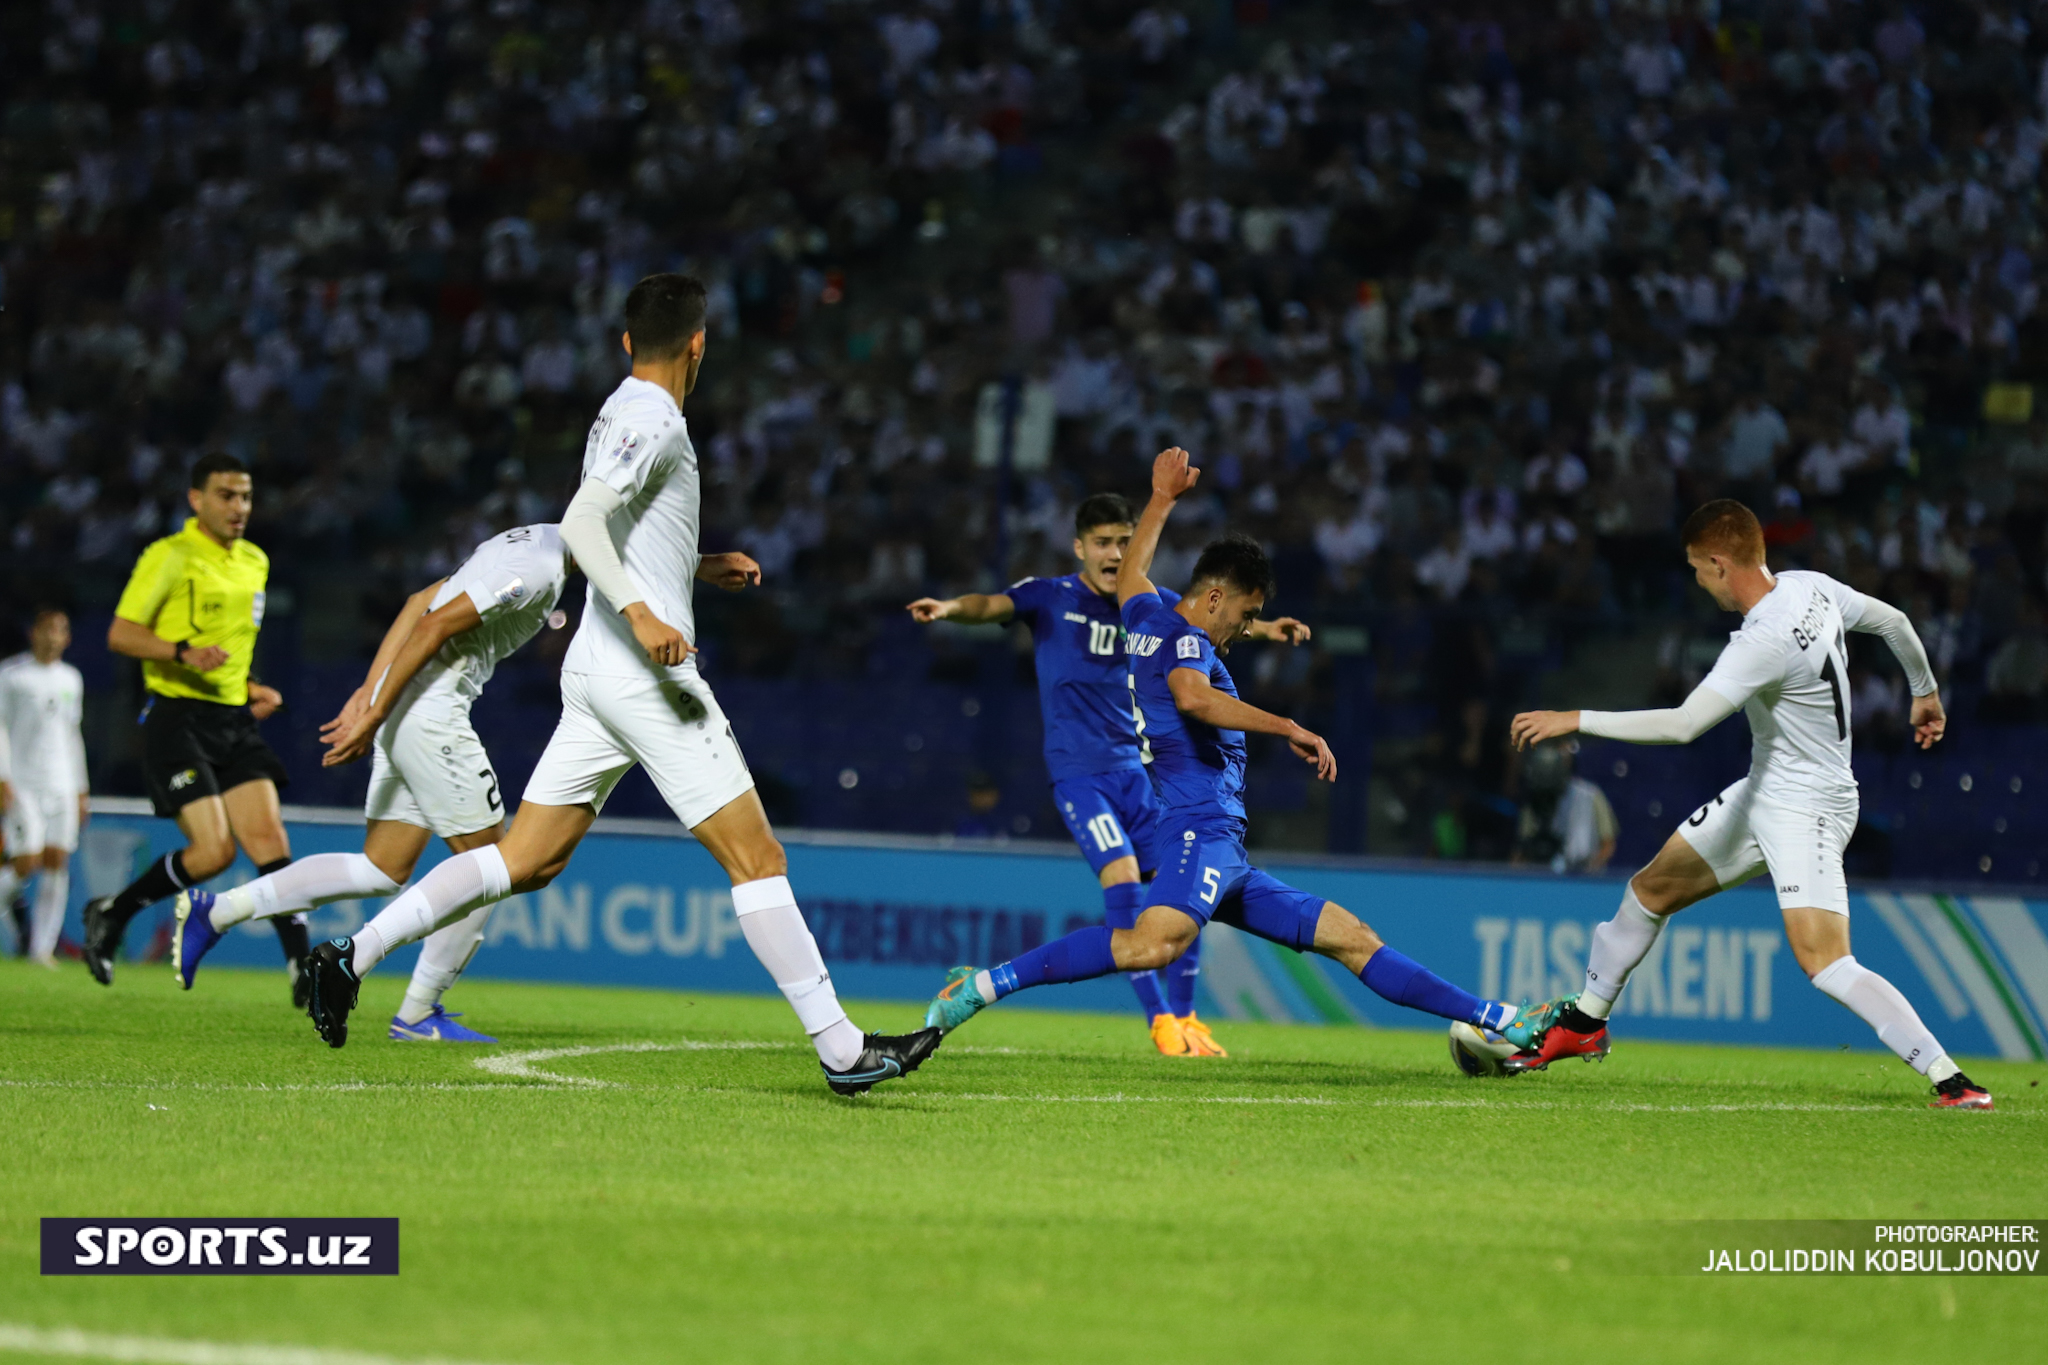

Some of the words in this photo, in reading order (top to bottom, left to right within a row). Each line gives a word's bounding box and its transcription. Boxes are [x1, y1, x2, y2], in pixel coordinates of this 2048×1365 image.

[1089, 620, 1117, 655] 10
[1087, 813, 1124, 852] 10
[1200, 866, 1221, 905] 5
[1779, 885, 1800, 894] JAKO
[603, 884, 742, 959] CUP
[797, 897, 1044, 968] ZBEKISTAN
[1474, 915, 1780, 1023] TASKENT
